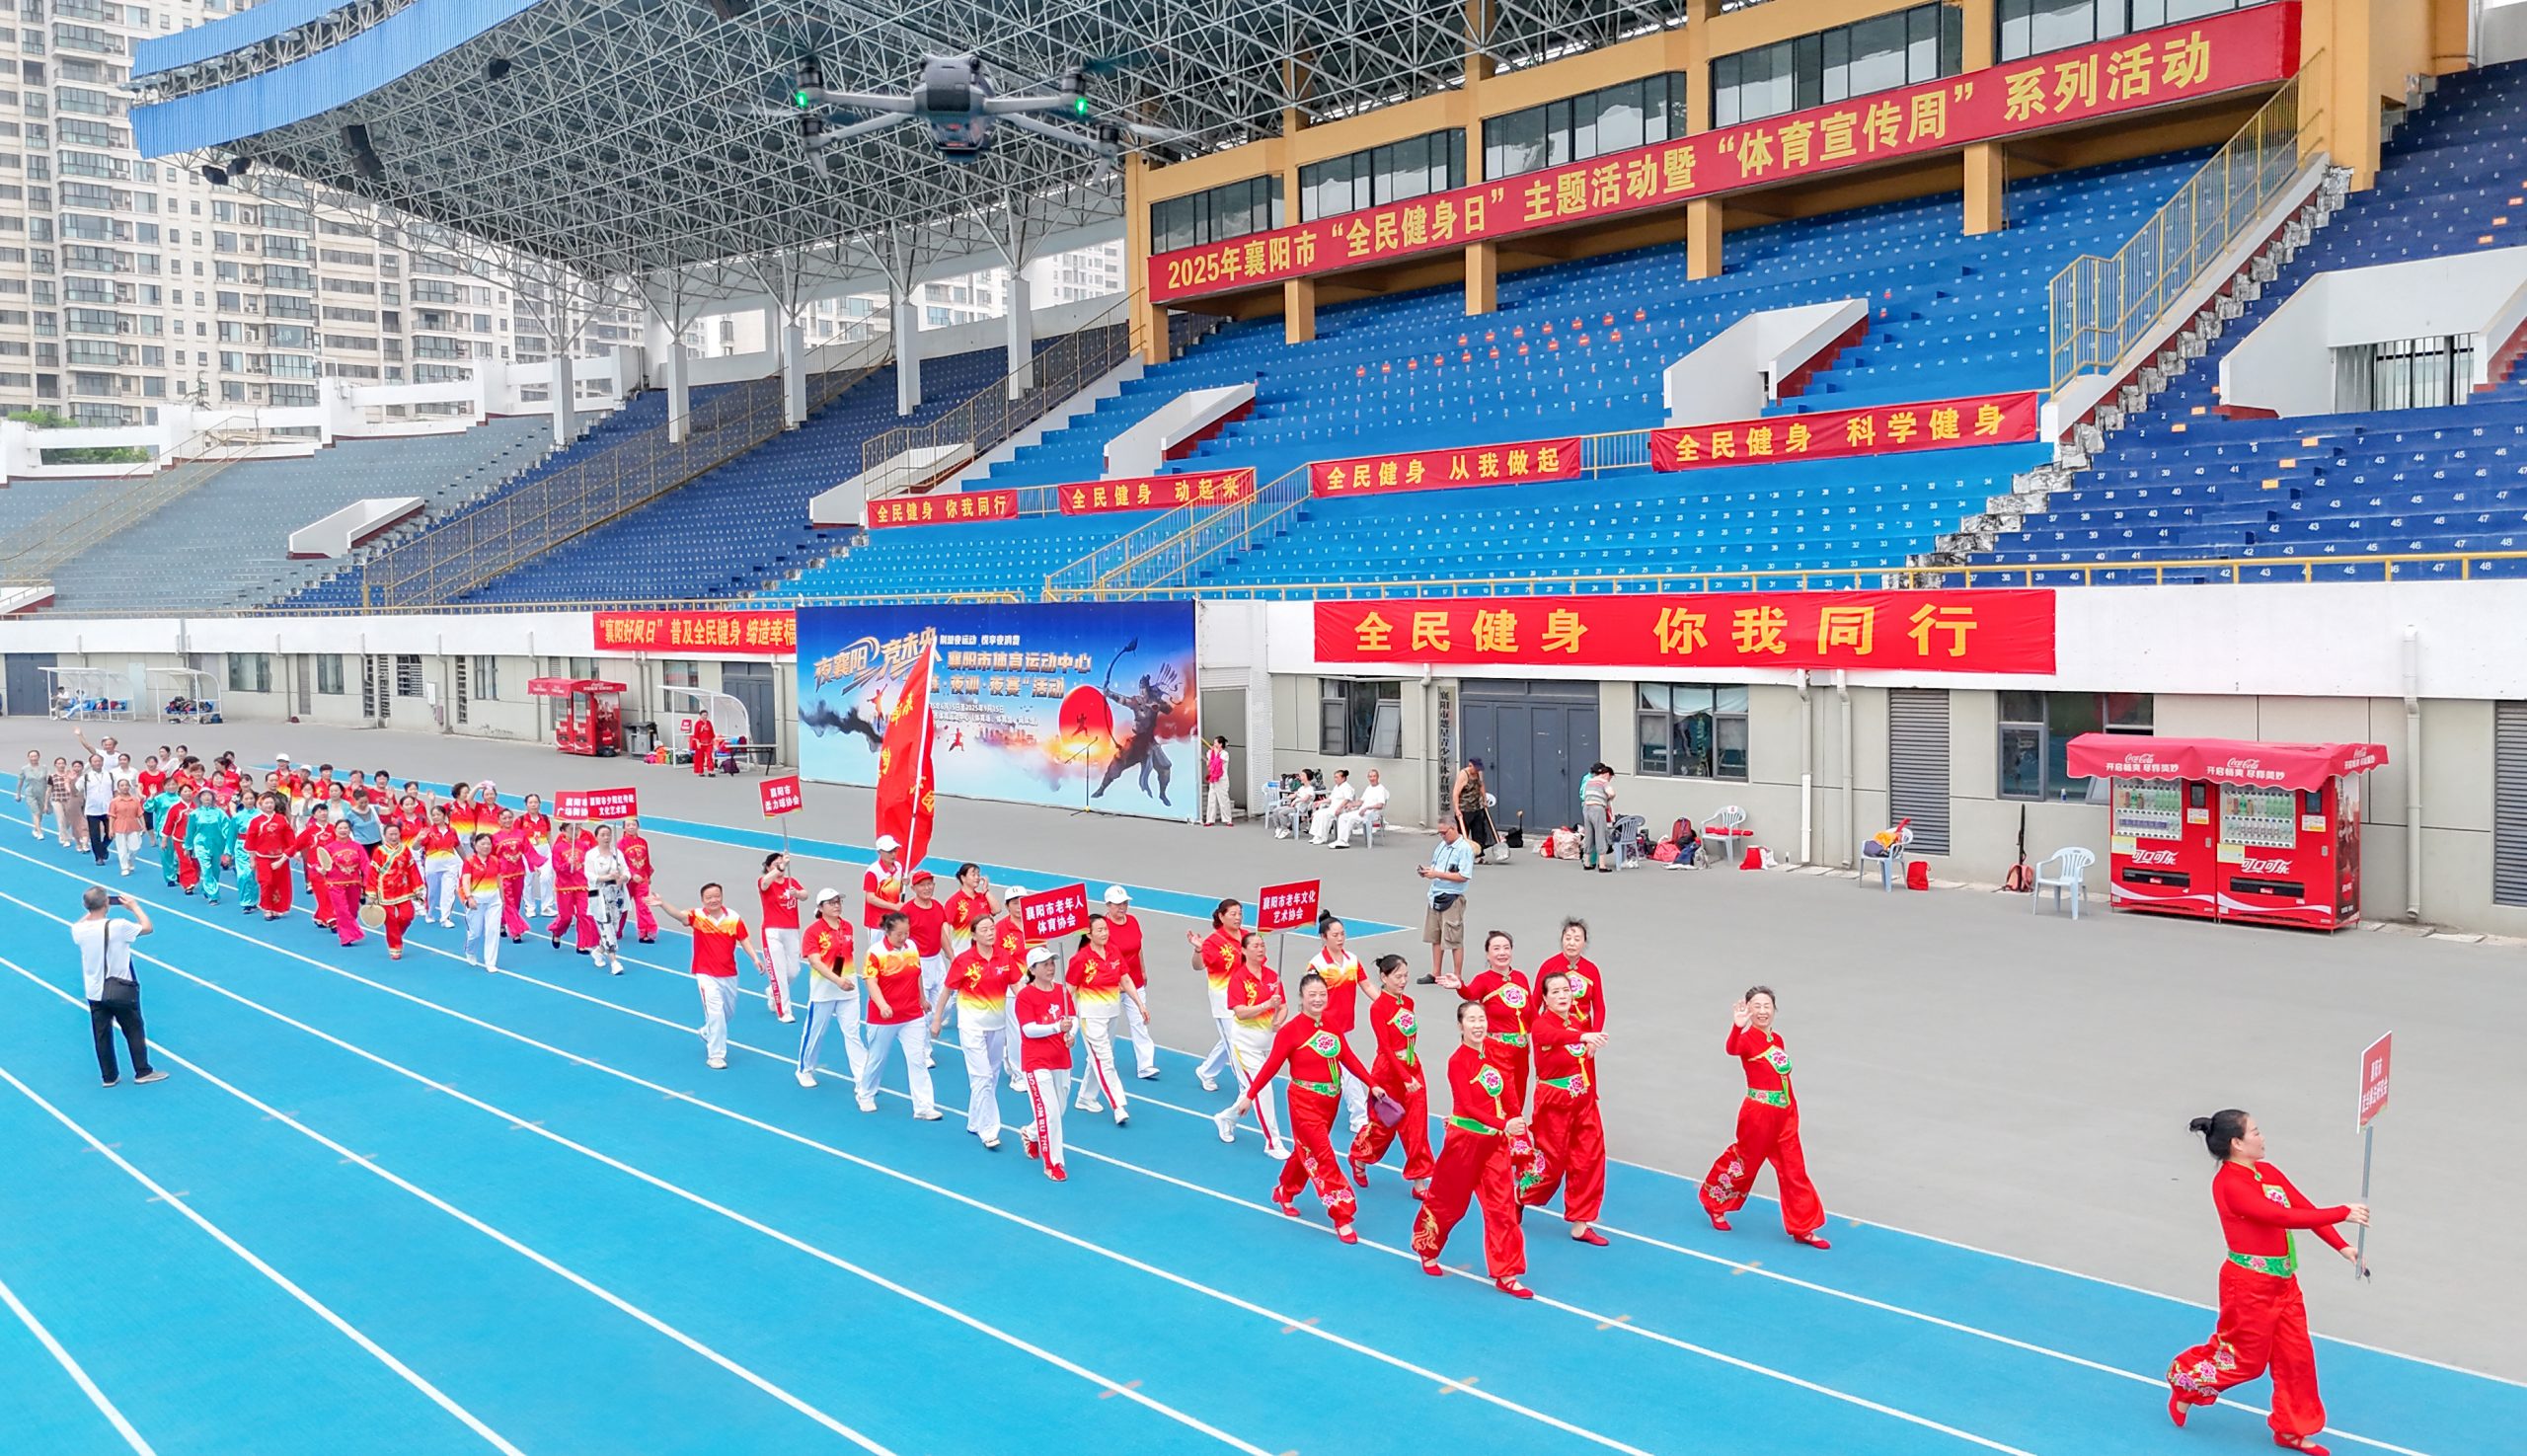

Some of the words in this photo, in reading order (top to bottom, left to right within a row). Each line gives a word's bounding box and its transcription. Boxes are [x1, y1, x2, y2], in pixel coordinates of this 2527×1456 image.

[1169, 232, 1317, 289] 2025年襄阳市
[1332, 191, 1503, 258] “全民健身日”
[1523, 143, 1696, 222] 主题活动暨
[1719, 81, 1972, 179] “体育宣传周”
[2005, 31, 2210, 120] 系列活动
[1675, 422, 1812, 462] 全民健身
[1847, 403, 2006, 444] 科学健身
[2472, 427, 2484, 436] 10
[2514, 425, 2524, 434] 11
[2454, 450, 2466, 459] 45
[2494, 447, 2507, 456] 46
[2374, 455, 2386, 464] 43
[2412, 453, 2425, 462] 44
[2336, 458, 2347, 467] 42
[1327, 459, 1425, 490] 全民健身
[1448, 447, 1560, 479] 从我做起
[2475, 468, 2488, 477] 46
[2517, 466, 2527, 475] 47
[2097, 472, 2106, 481] 37
[2392, 473, 2405, 482] 44
[2432, 470, 2445, 480] 45
[2314, 478, 2326, 487] 42
[2352, 475, 2365, 485] 43
[1072, 484, 1152, 509] 全民健身
[1175, 475, 1241, 501] 动起来
[2171, 487, 2182, 496] 40
[2206, 485, 2216, 494] 41
[2072, 493, 2083, 501] 37
[2452, 493, 2465, 501] 46
[2495, 490, 2509, 499] 47
[2329, 499, 2341, 508] 43
[2369, 498, 2382, 506] 44
[2411, 495, 2423, 504] 45
[877, 501, 933, 523] 全民健身
[945, 495, 1007, 519] 你我同行
[2290, 501, 2302, 510] 42
[2048, 513, 2058, 523] 37
[2147, 509, 2159, 518] 40
[2477, 513, 2490, 523] 47
[2348, 520, 2360, 529] 44
[2390, 517, 2403, 527] 45
[2433, 515, 2446, 525] 46
[2268, 523, 2280, 533] 42
[2308, 522, 2320, 531] 43
[2122, 529, 2133, 538] 40
[2158, 528, 2169, 537] 41
[2022, 533, 2031, 542] 37
[2499, 537, 2513, 547] 48
[2366, 542, 2379, 552] 45
[2409, 540, 2422, 550] 46
[2454, 539, 2468, 549] 47
[2243, 547, 2255, 557] 42
[2282, 545, 2295, 555] 43
[2324, 544, 2336, 554] 44
[1994, 554, 2005, 563] 37
[2095, 552, 2106, 561] 40
[2131, 551, 2141, 560] 41
[2343, 565, 2356, 575] 45
[2432, 563, 2446, 573] 47
[2479, 561, 2492, 571] 48
[2069, 572, 2080, 580] 40
[2105, 571, 2115, 580] 41
[2219, 569, 2231, 577] 42
[2259, 568, 2271, 577] 43
[670, 618, 741, 646] 普及全民健身
[1355, 609, 1587, 653] 全民健身
[1653, 603, 1977, 657] 你我同行
[948, 651, 1093, 673] 襄阳市体育运动中心
[770, 785, 792, 799] 襄阳市
[2132, 849, 2179, 865] 可口可乐
[2242, 858, 2292, 875] 可口可乐
[1263, 889, 1316, 911] 襄阳市老年文化
[1025, 896, 1085, 920] 襄阳市老年人
[1273, 906, 1304, 924] 艺术协会
[1037, 913, 1077, 935] 体育协会
